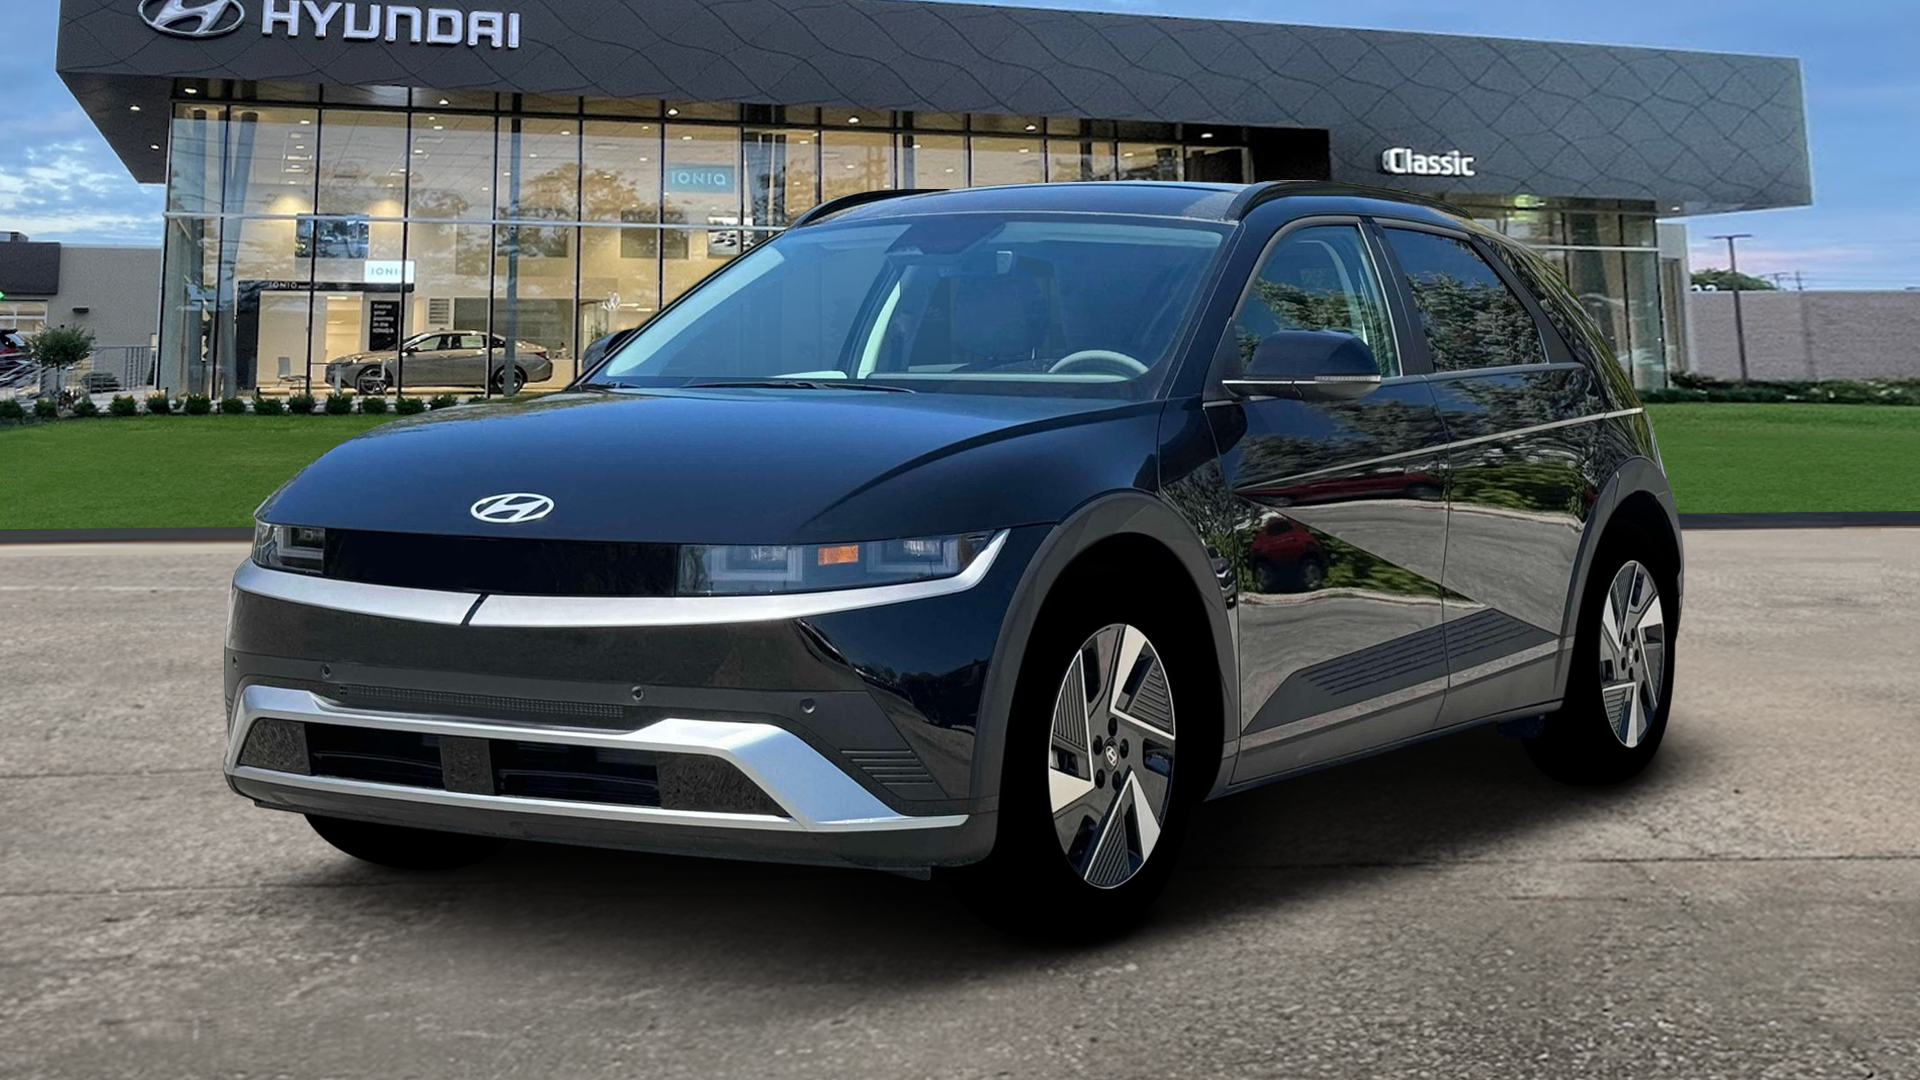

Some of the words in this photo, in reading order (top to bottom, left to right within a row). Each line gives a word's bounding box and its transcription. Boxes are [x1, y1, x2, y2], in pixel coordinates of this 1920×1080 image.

[261, 0, 520, 49] HYUNDAI
[1383, 147, 1476, 177] Classic
[671, 172, 726, 186] IONIQ
[371, 267, 404, 276] IONI
